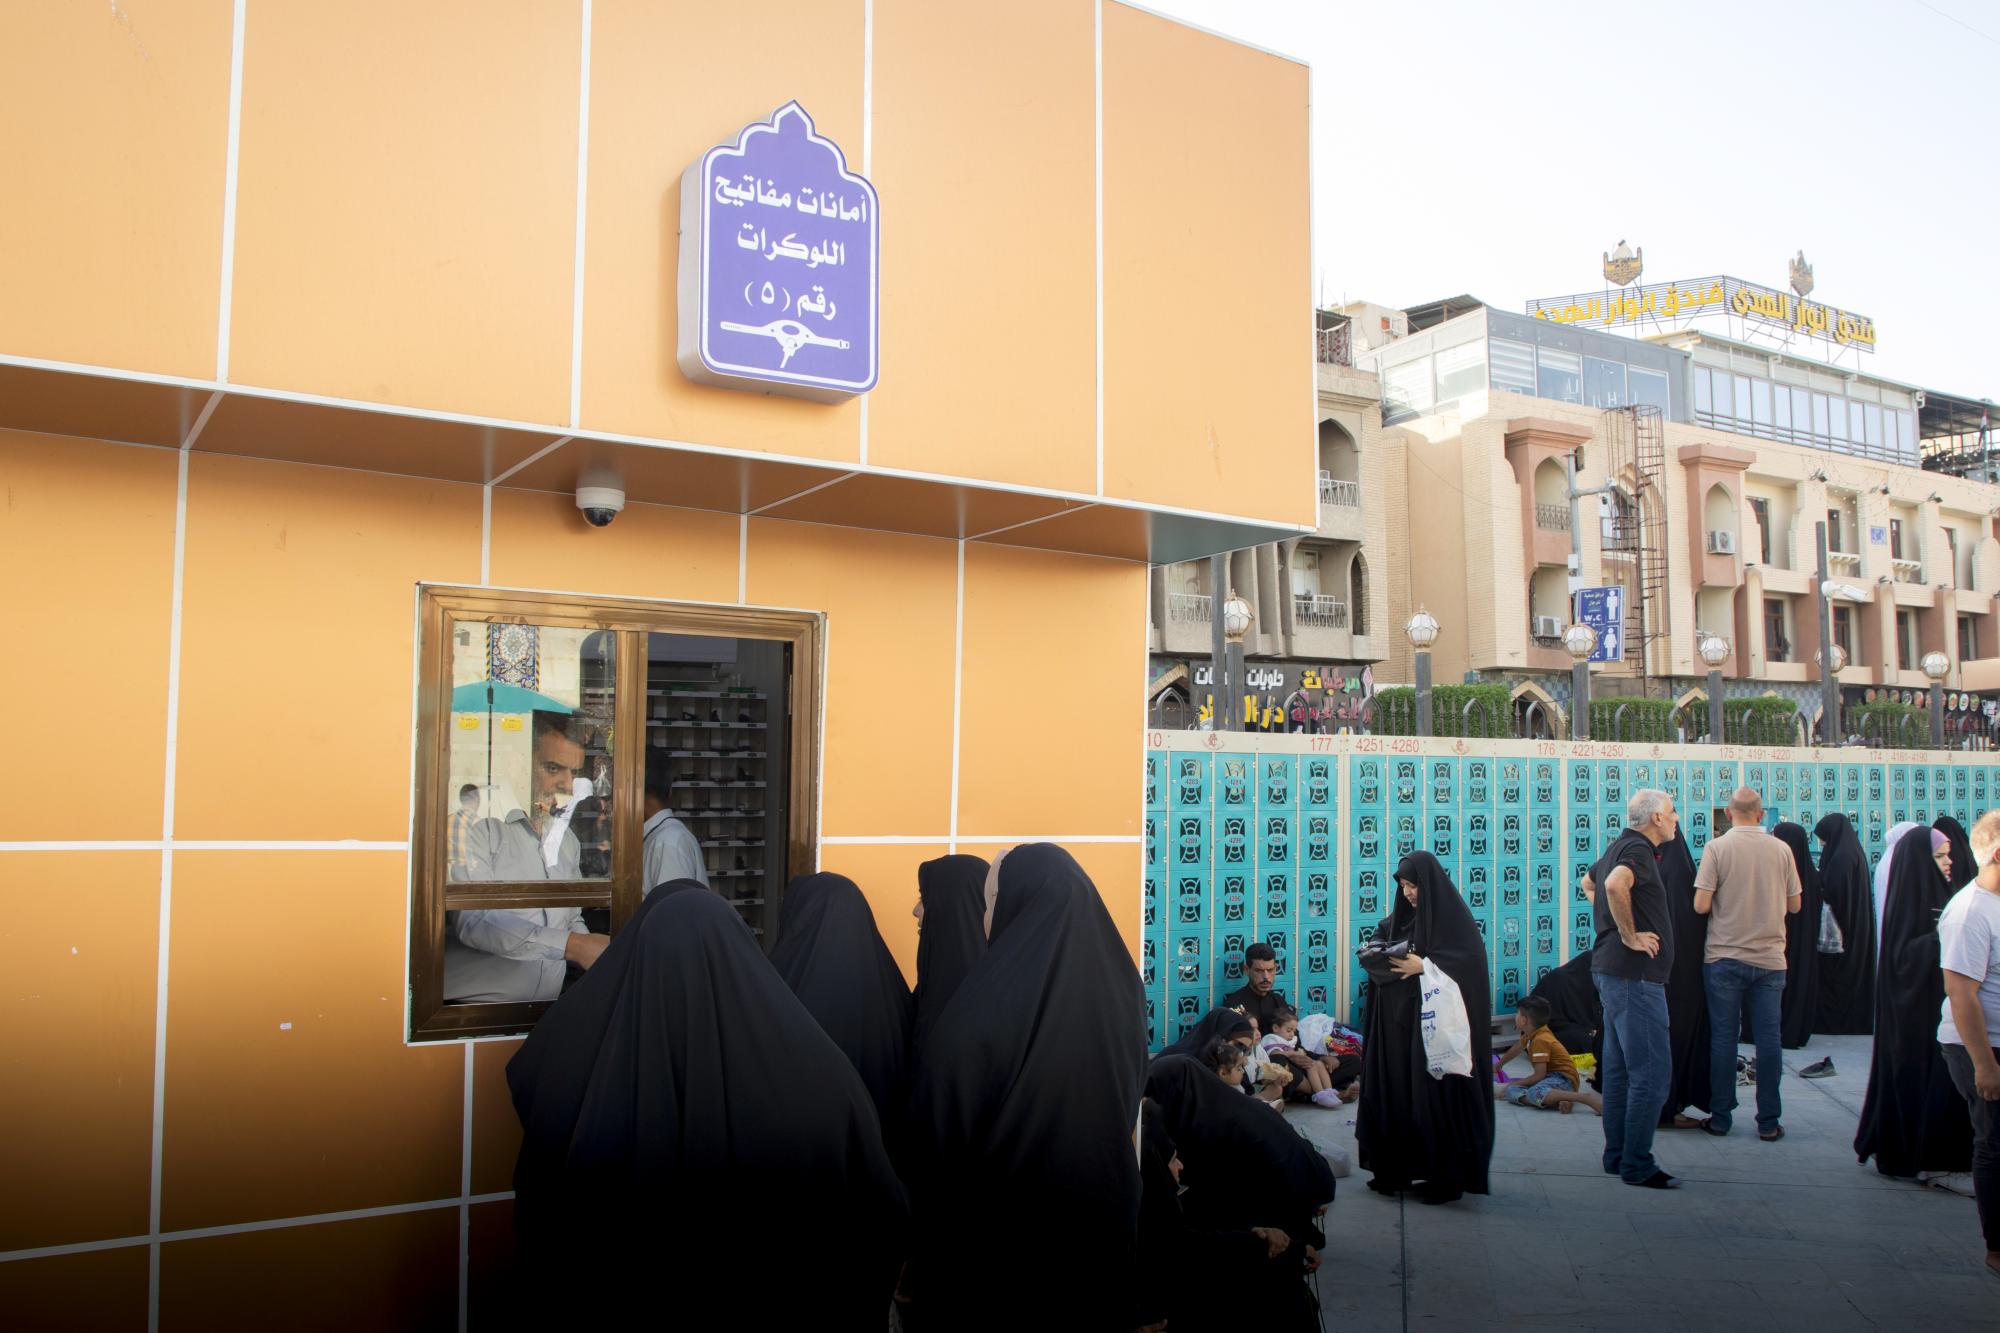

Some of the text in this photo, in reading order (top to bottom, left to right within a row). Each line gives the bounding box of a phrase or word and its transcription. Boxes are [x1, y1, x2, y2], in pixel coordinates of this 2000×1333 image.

[715, 174, 867, 223] أمانات مفاتيح
[737, 223, 845, 268] اللوكرات
[797, 285, 836, 320] رقم
[1604, 289, 1656, 324] انوار
[1660, 282, 1723, 316] فندق
[1833, 310, 1876, 344] فندق
[1246, 668, 1284, 690] حلويات
[1310, 738, 1332, 752] 177
[1355, 738, 1420, 753] 4251-4280
[1537, 742, 1556, 756] 176
